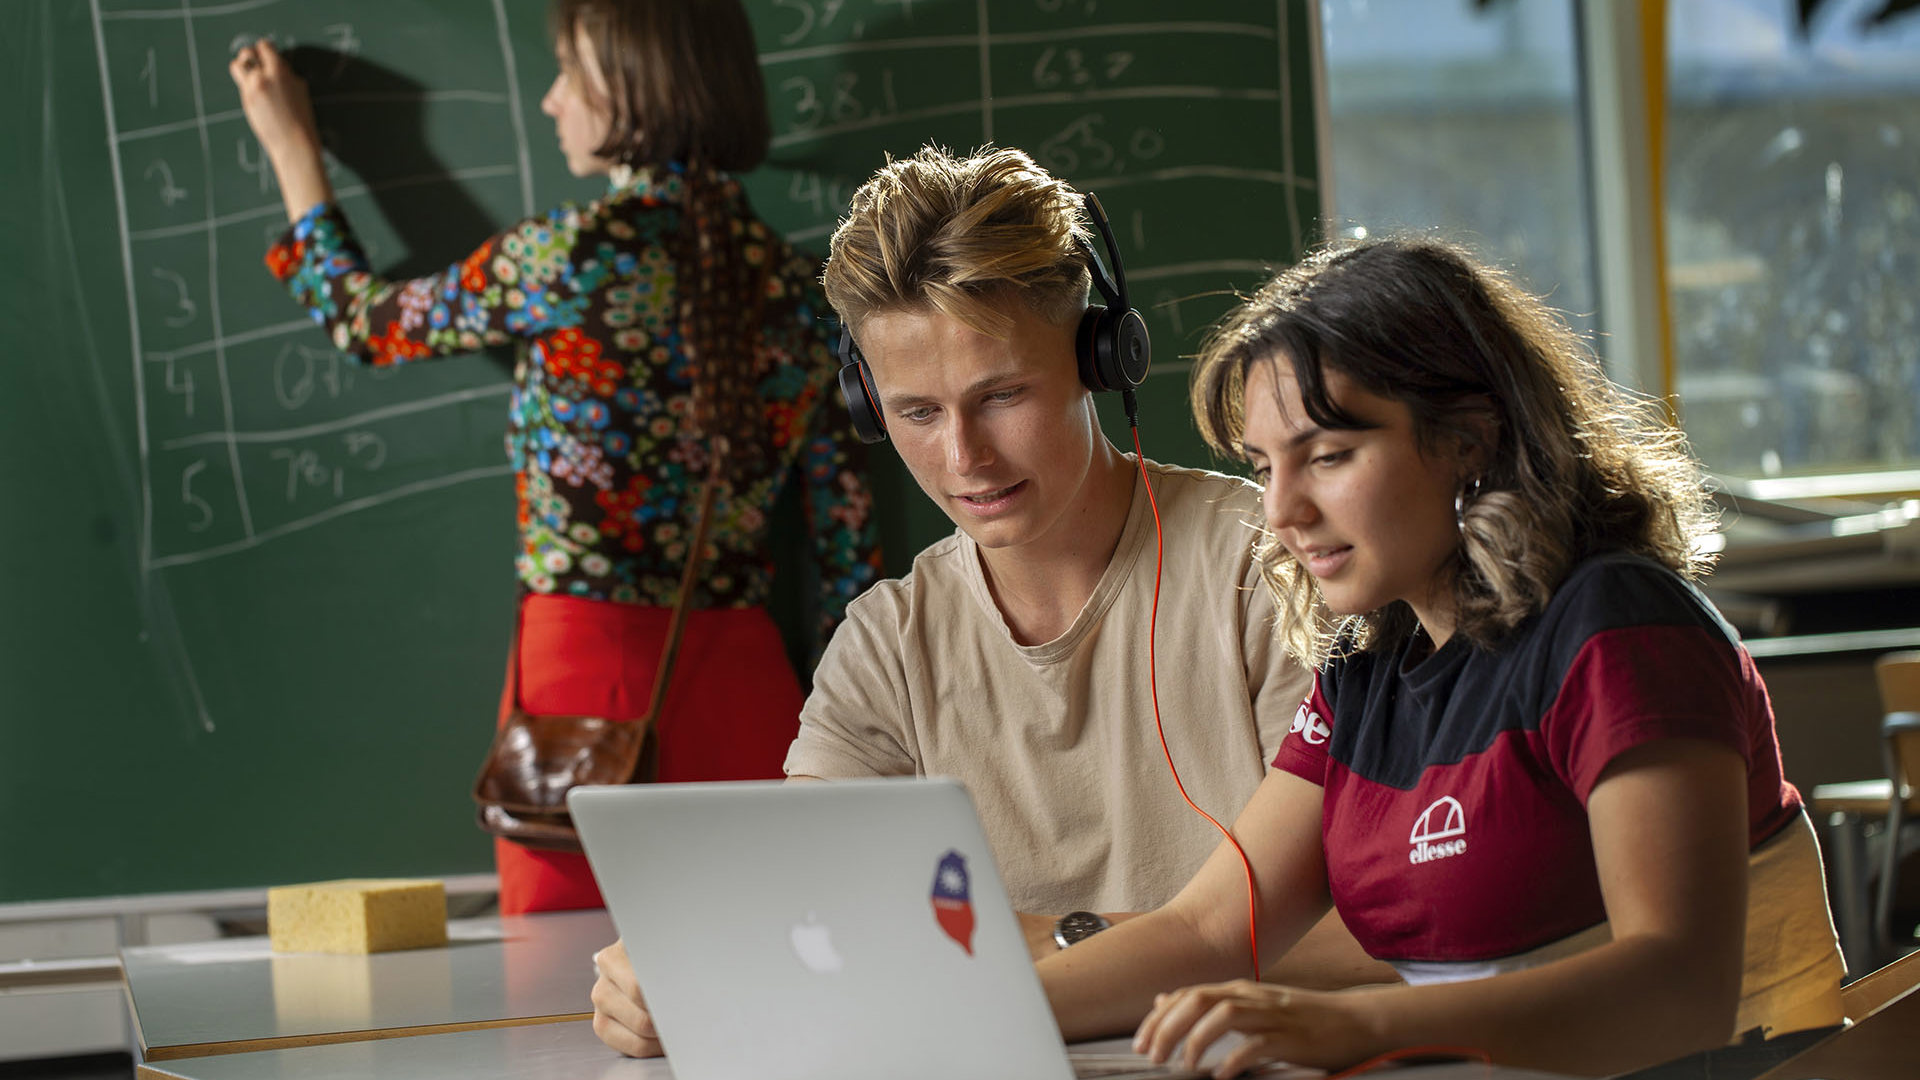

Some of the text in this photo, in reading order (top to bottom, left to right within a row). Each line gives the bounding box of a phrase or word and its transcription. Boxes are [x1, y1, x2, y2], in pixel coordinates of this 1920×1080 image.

[139, 47, 159, 109] 1
[152, 266, 197, 328] 3
[181, 459, 213, 533] 5
[1409, 838, 1467, 865] ellesse
